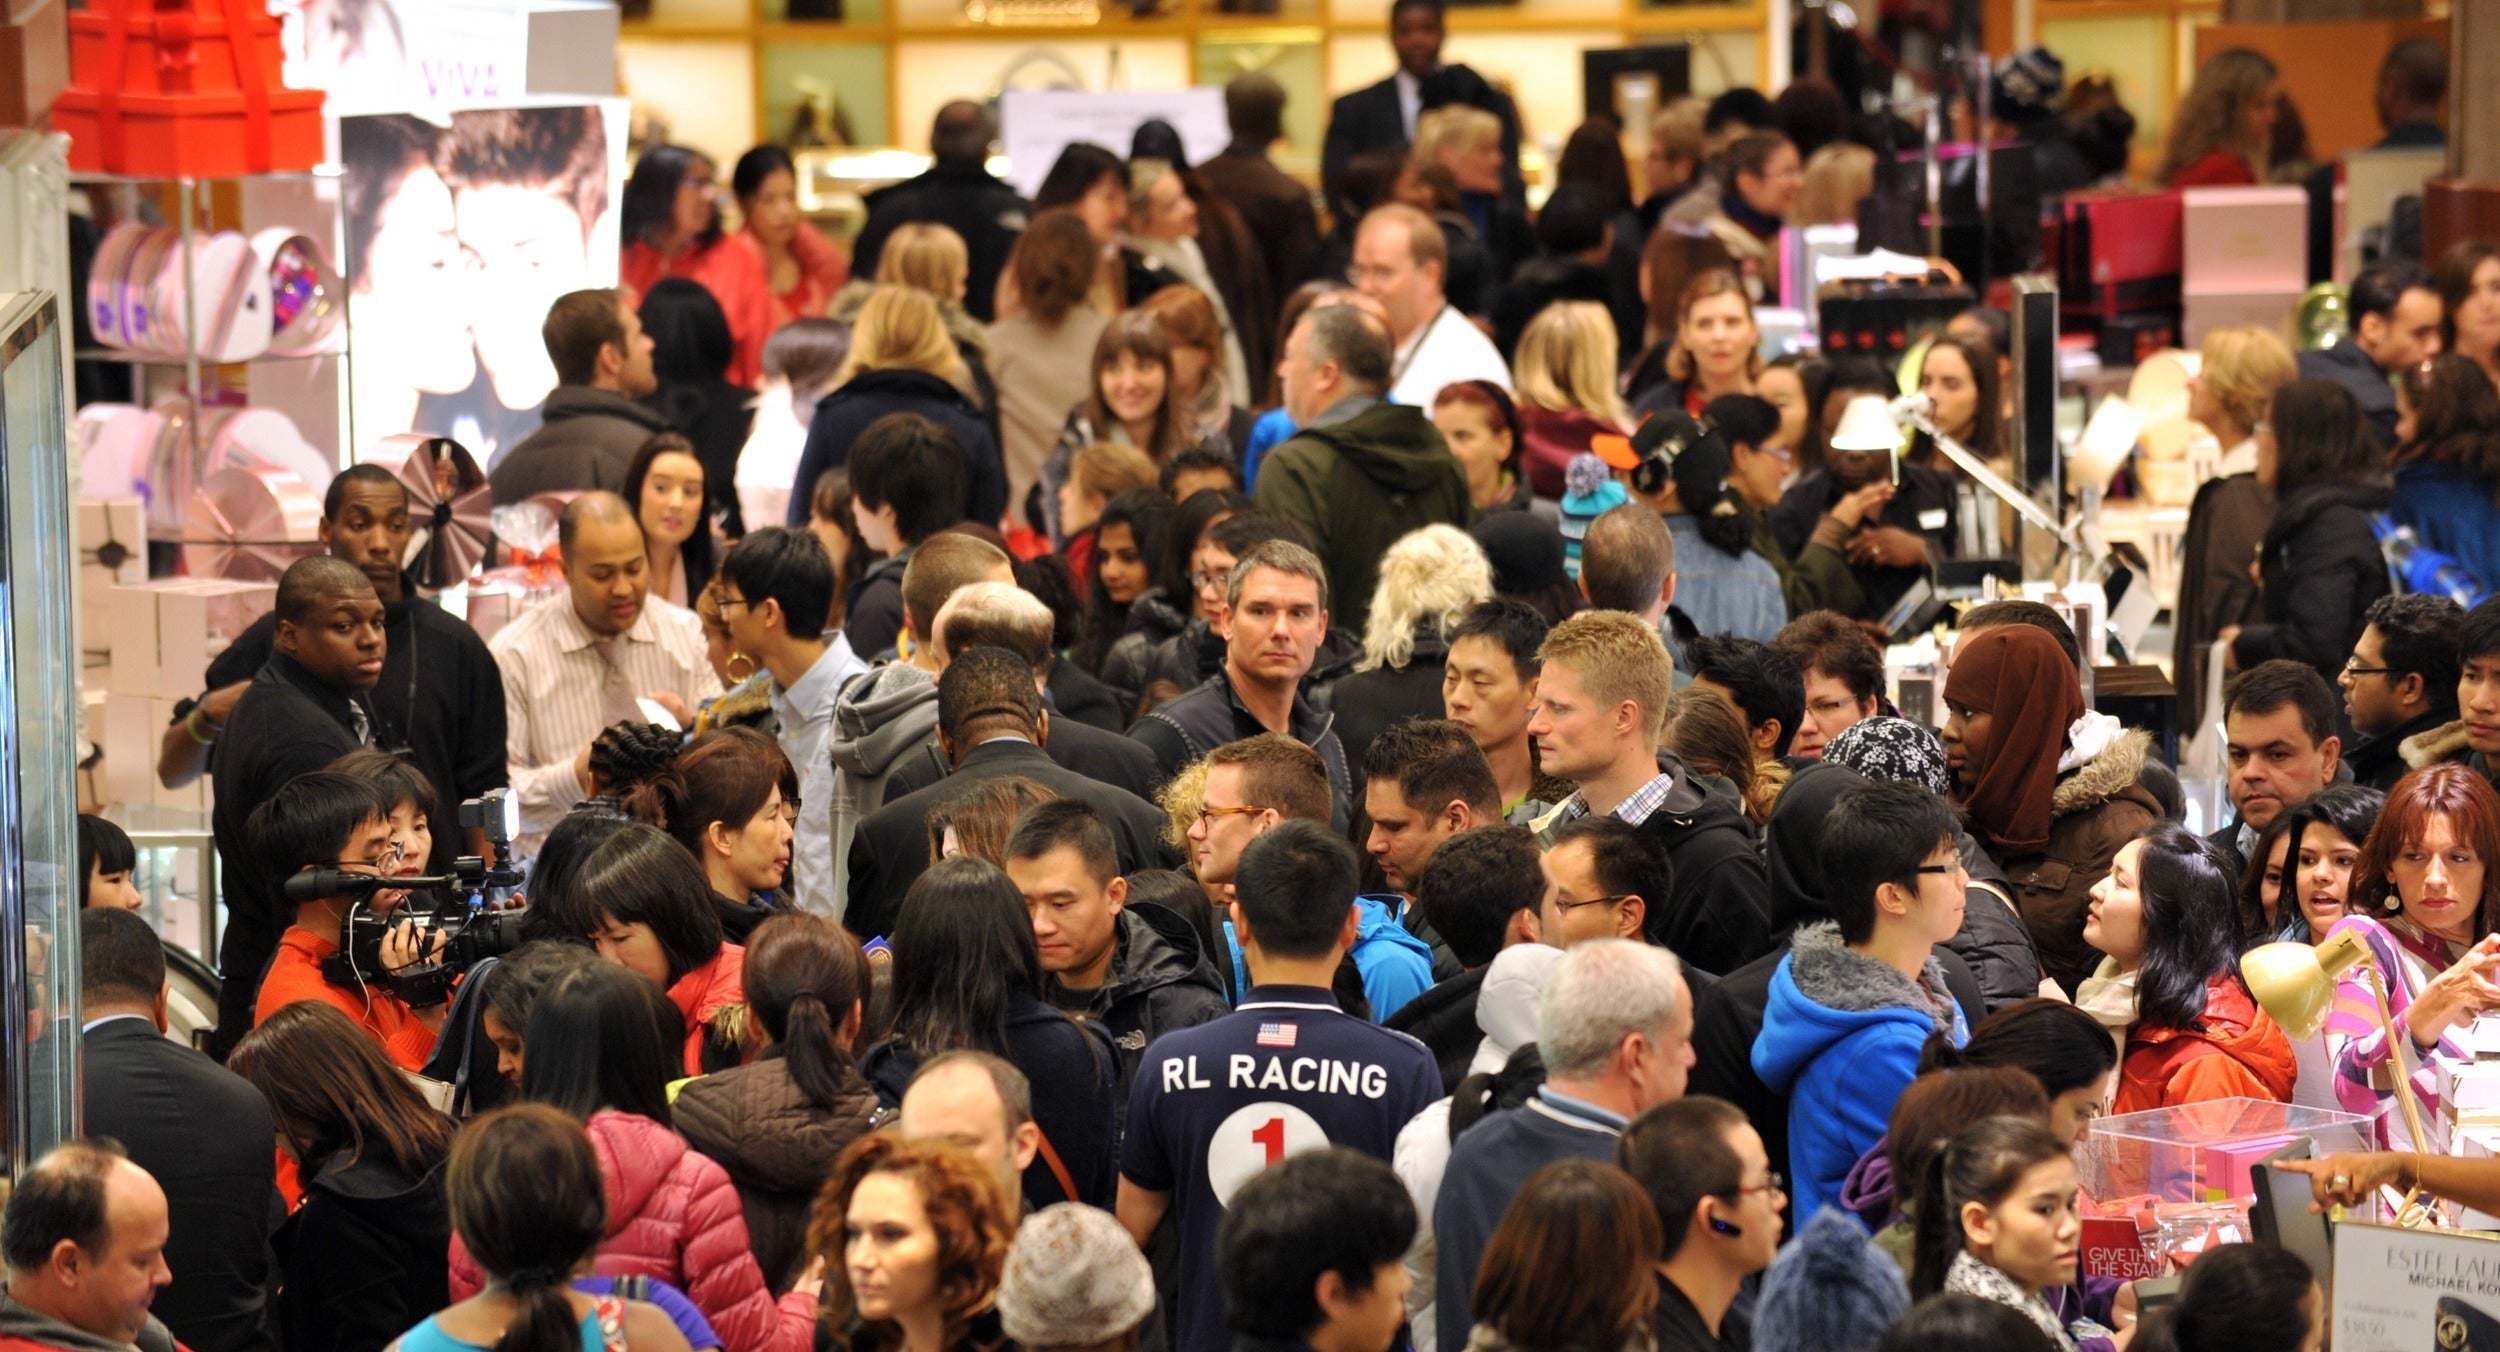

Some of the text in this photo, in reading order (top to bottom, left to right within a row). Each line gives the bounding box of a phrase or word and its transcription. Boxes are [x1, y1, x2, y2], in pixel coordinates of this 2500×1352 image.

[1162, 1053, 1388, 1100] RL RACING
[1252, 1118, 1286, 1168] 1
[2088, 1246, 2126, 1262] GIVE
[2453, 1251, 2500, 1281] LAU
[2089, 1260, 2119, 1276] THE
[2408, 1272, 2500, 1297] MICHAEL KO
